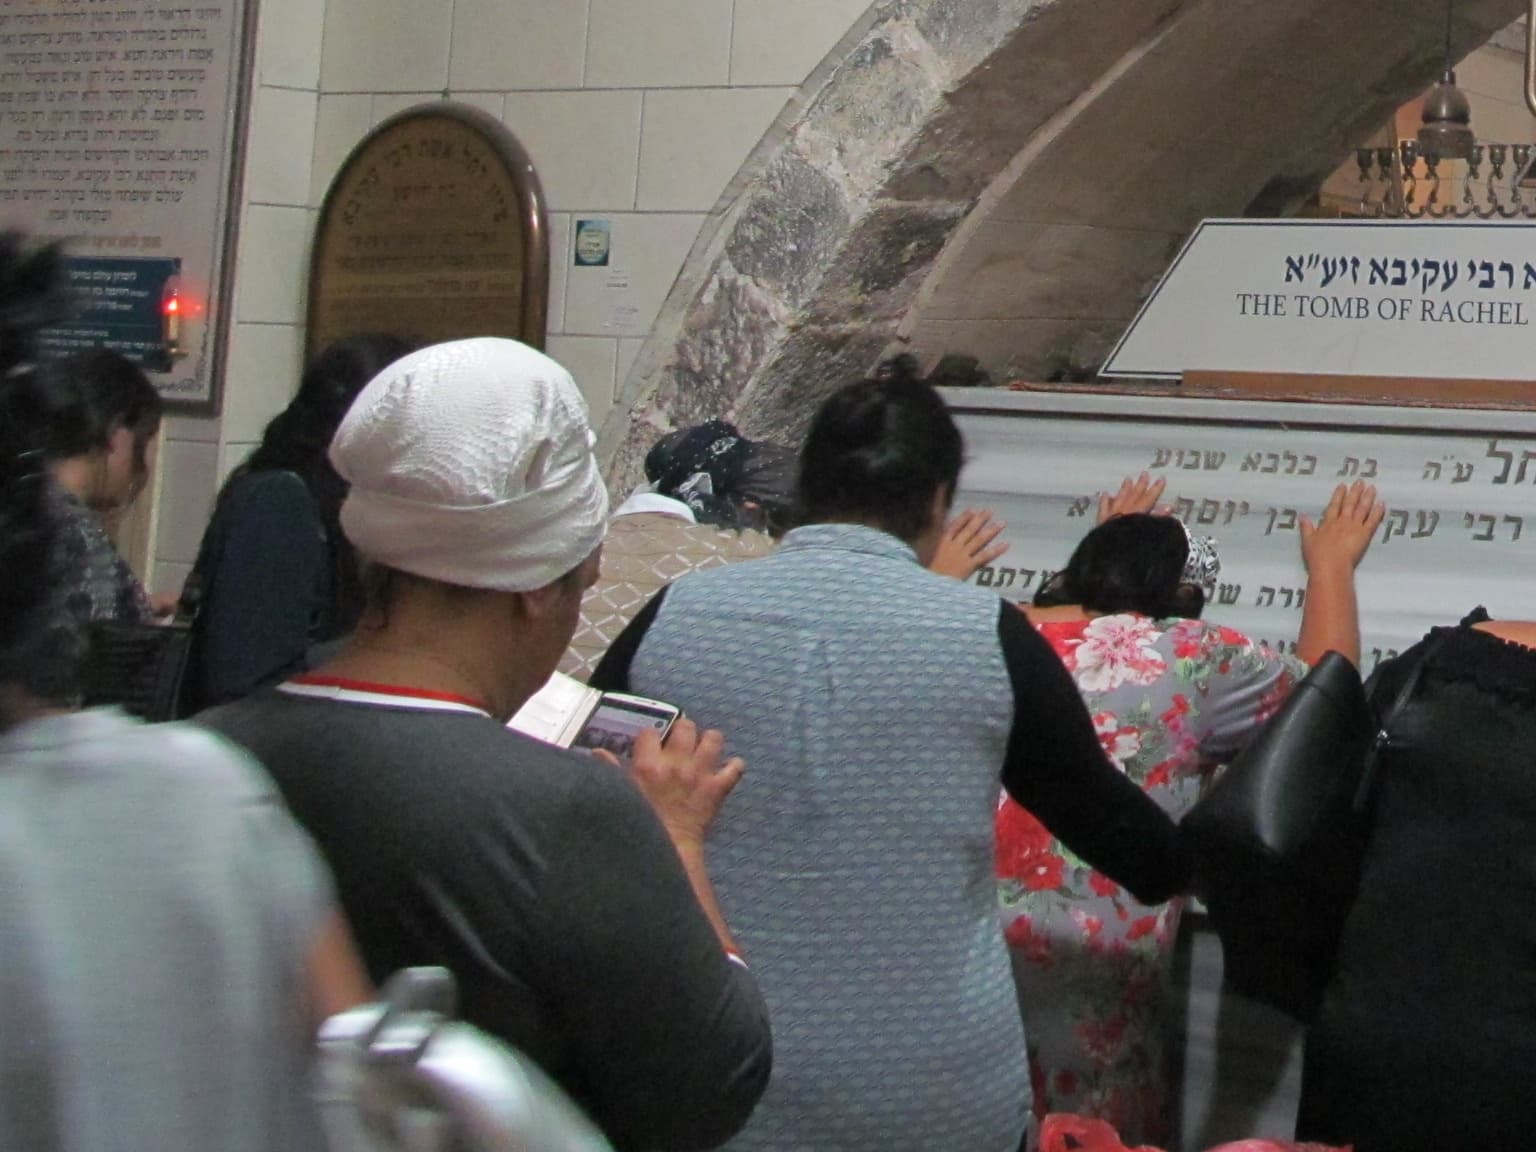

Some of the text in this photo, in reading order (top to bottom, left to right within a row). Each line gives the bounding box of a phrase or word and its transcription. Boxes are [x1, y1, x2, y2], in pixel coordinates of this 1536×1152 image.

[1284, 252, 1361, 289] זיע"א
[1368, 257, 1459, 295] עקיבא
[1466, 258, 1515, 290] רבי
[1236, 292, 1288, 318] THE
[1294, 294, 1372, 321] TOMB
[1376, 298, 1414, 323] OF
[1419, 299, 1529, 327] RACHEL
[1149, 447, 1227, 472] שבוע
[1240, 448, 1318, 477] כלבא
[1336, 454, 1379, 479] בת
[1264, 506, 1298, 537] בן
[1463, 509, 1524, 542] רבי
